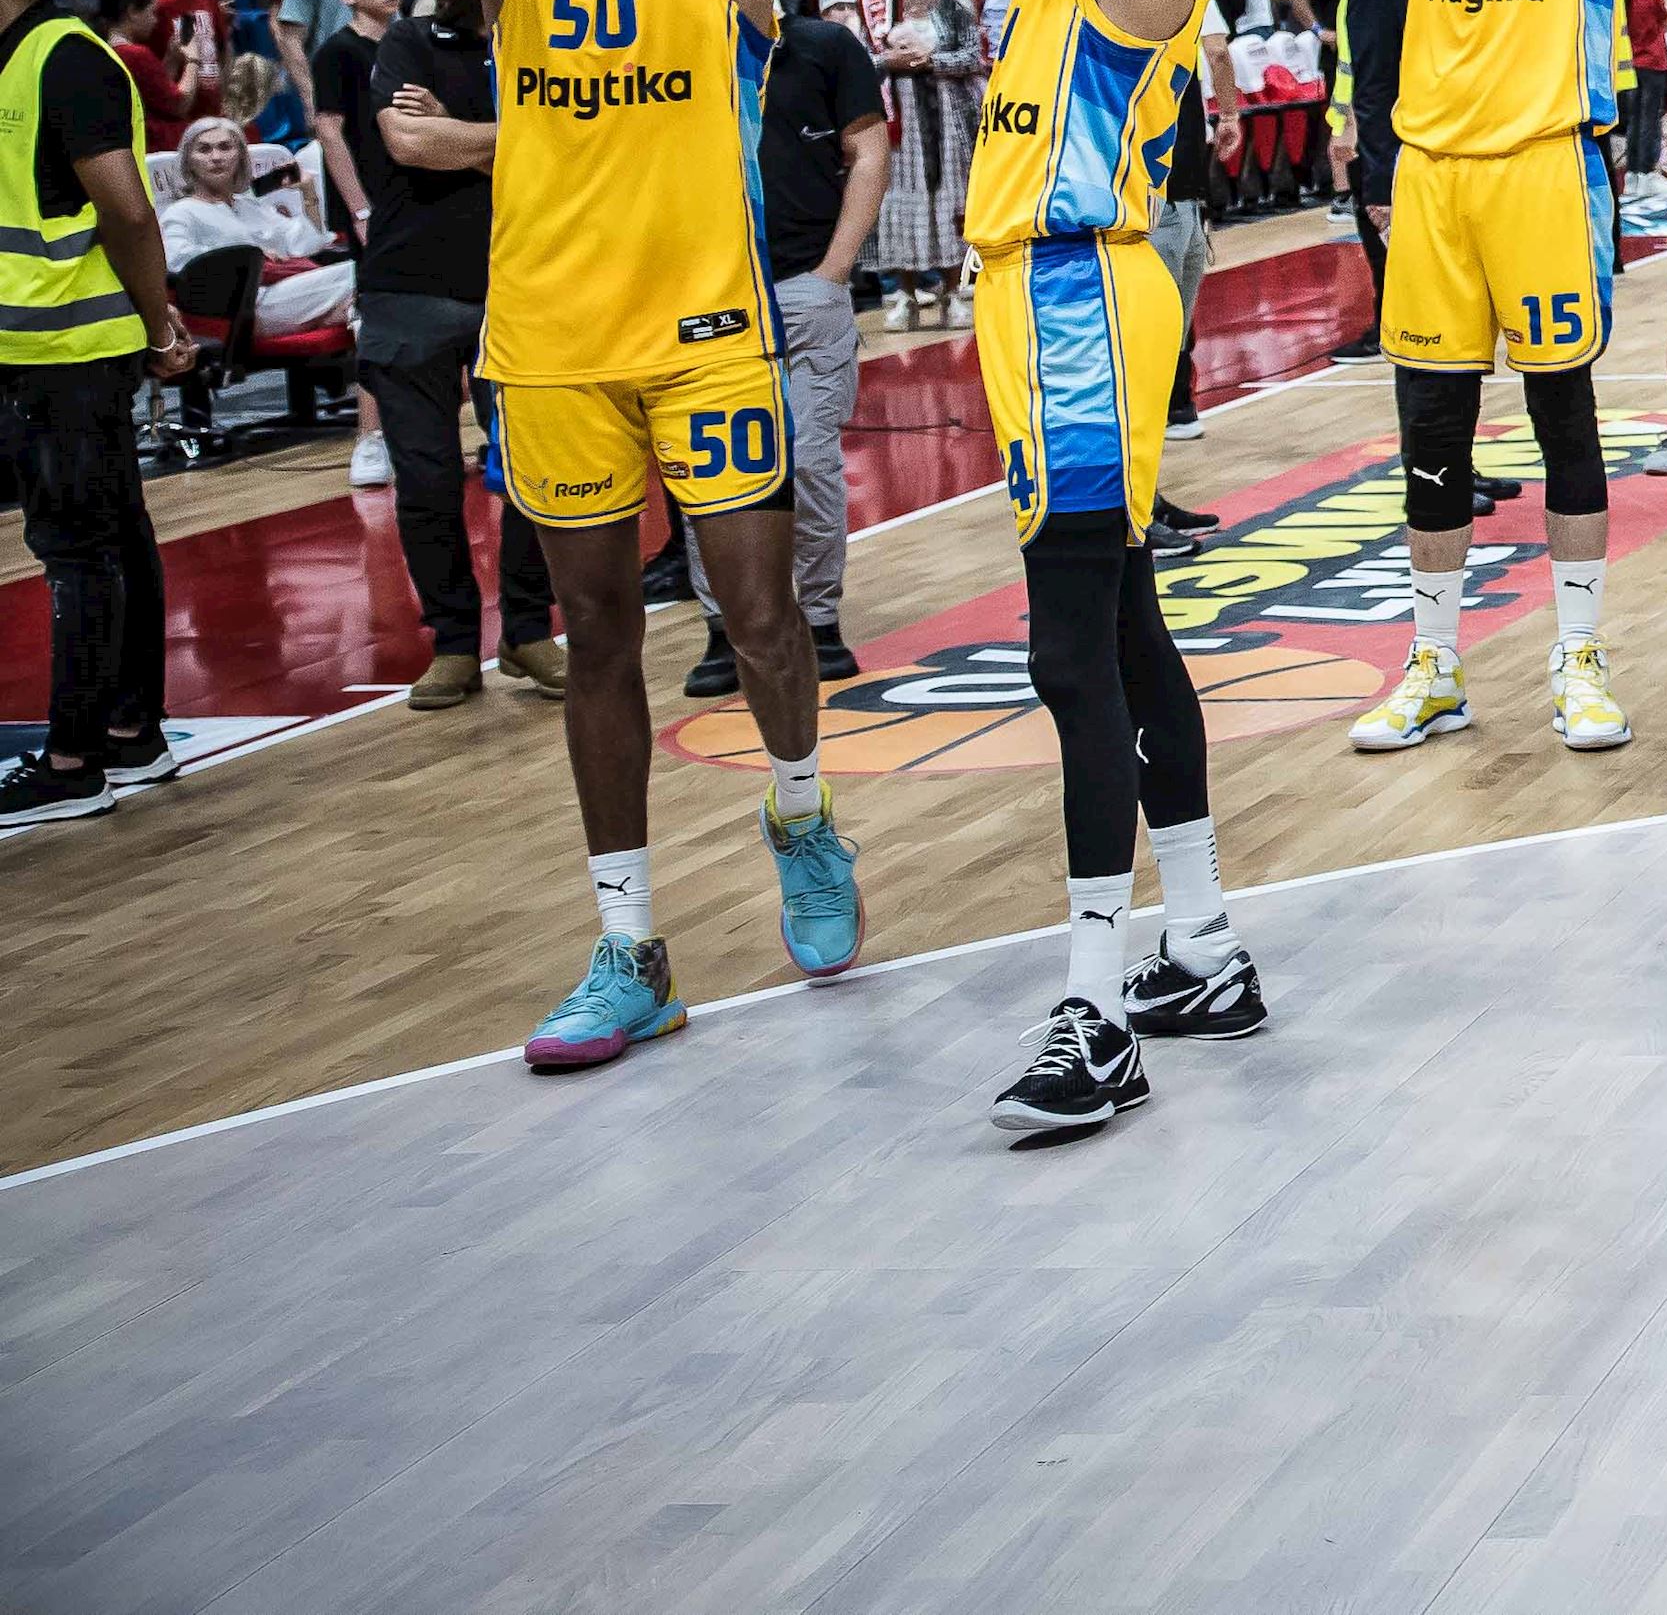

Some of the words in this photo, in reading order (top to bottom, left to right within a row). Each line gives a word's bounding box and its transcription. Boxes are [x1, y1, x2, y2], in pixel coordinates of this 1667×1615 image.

[516, 63, 692, 120] Playtika
[719, 313, 736, 327] XL
[1521, 293, 1582, 345] 15
[1400, 331, 1441, 347] Rapyd
[690, 407, 776, 478] 50
[555, 473, 613, 498] Rapyd
